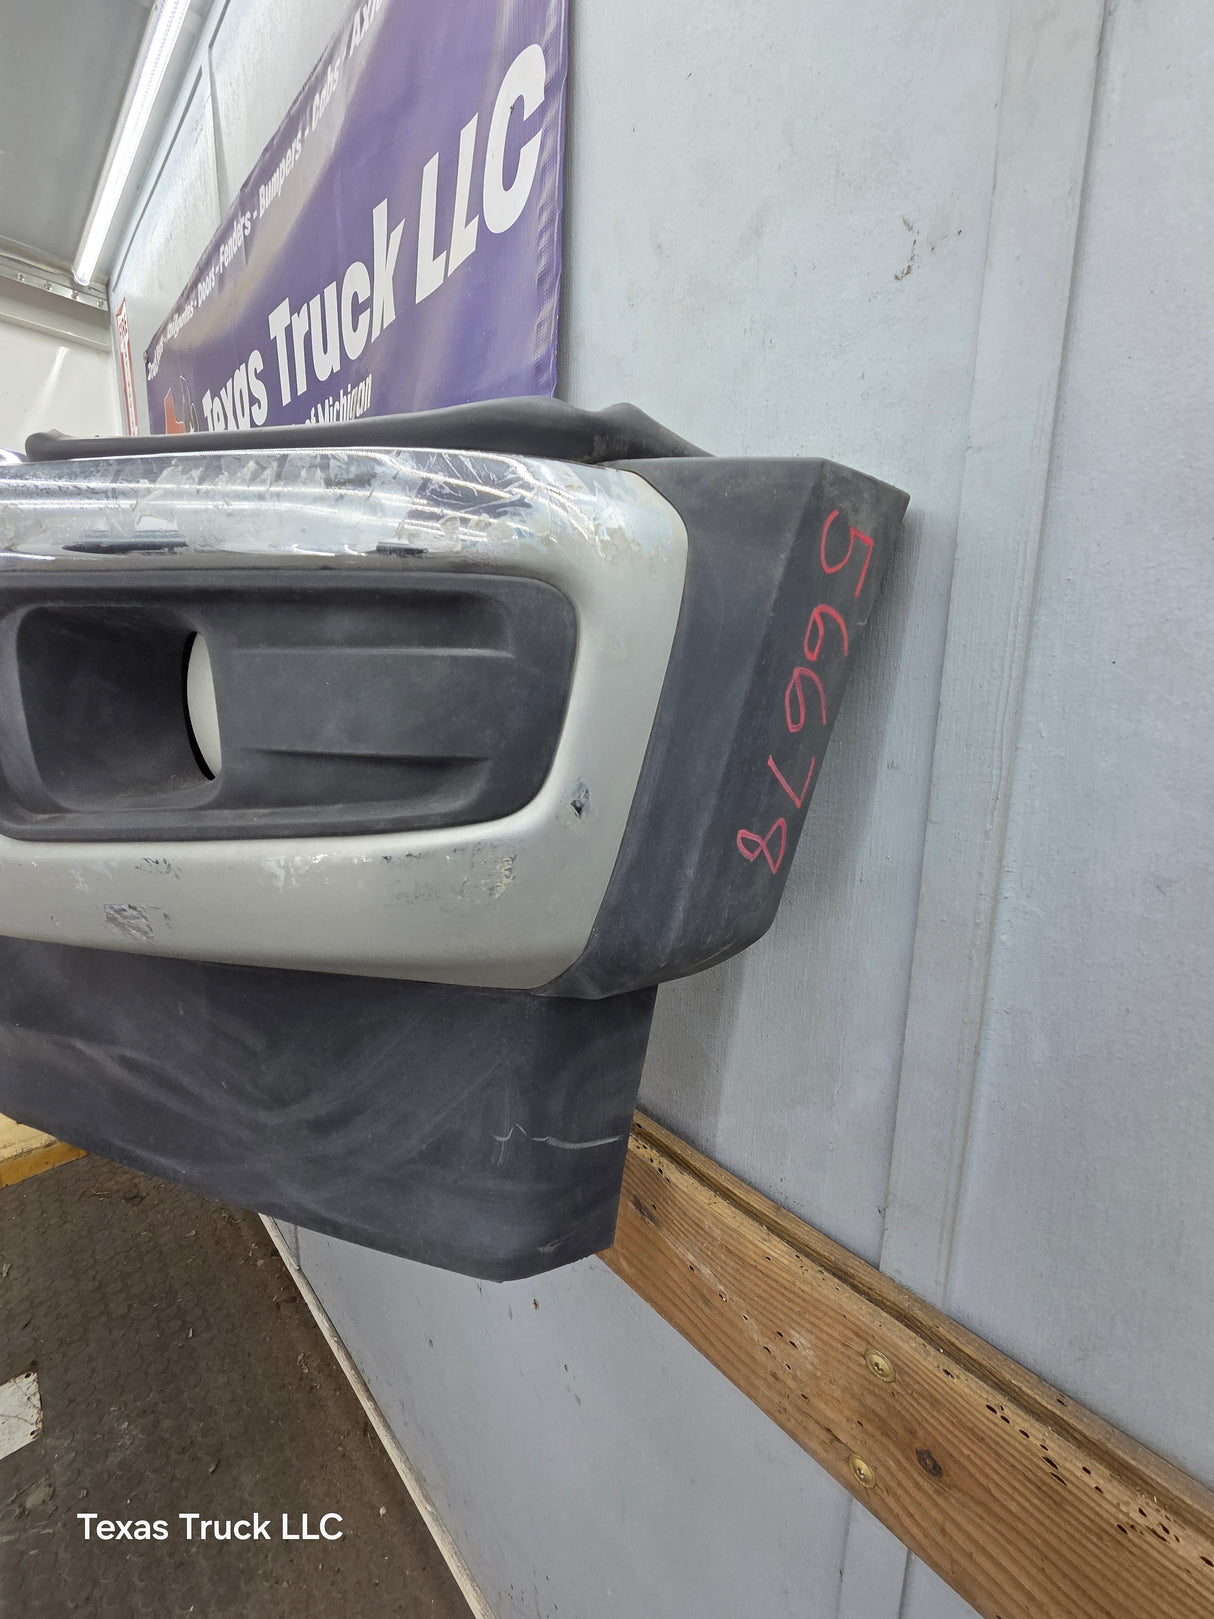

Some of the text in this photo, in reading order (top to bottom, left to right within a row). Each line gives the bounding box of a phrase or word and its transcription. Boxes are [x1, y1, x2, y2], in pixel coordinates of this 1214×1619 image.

[202, 349, 268, 431] Texas
[268, 198, 405, 406] Truck
[415, 43, 546, 305] LLC
[219, 211, 251, 273] Fenders
[258, 130, 302, 219] Bumpers
[311, 57, 340, 131] Cabs
[736, 508, 874, 875] 56678
